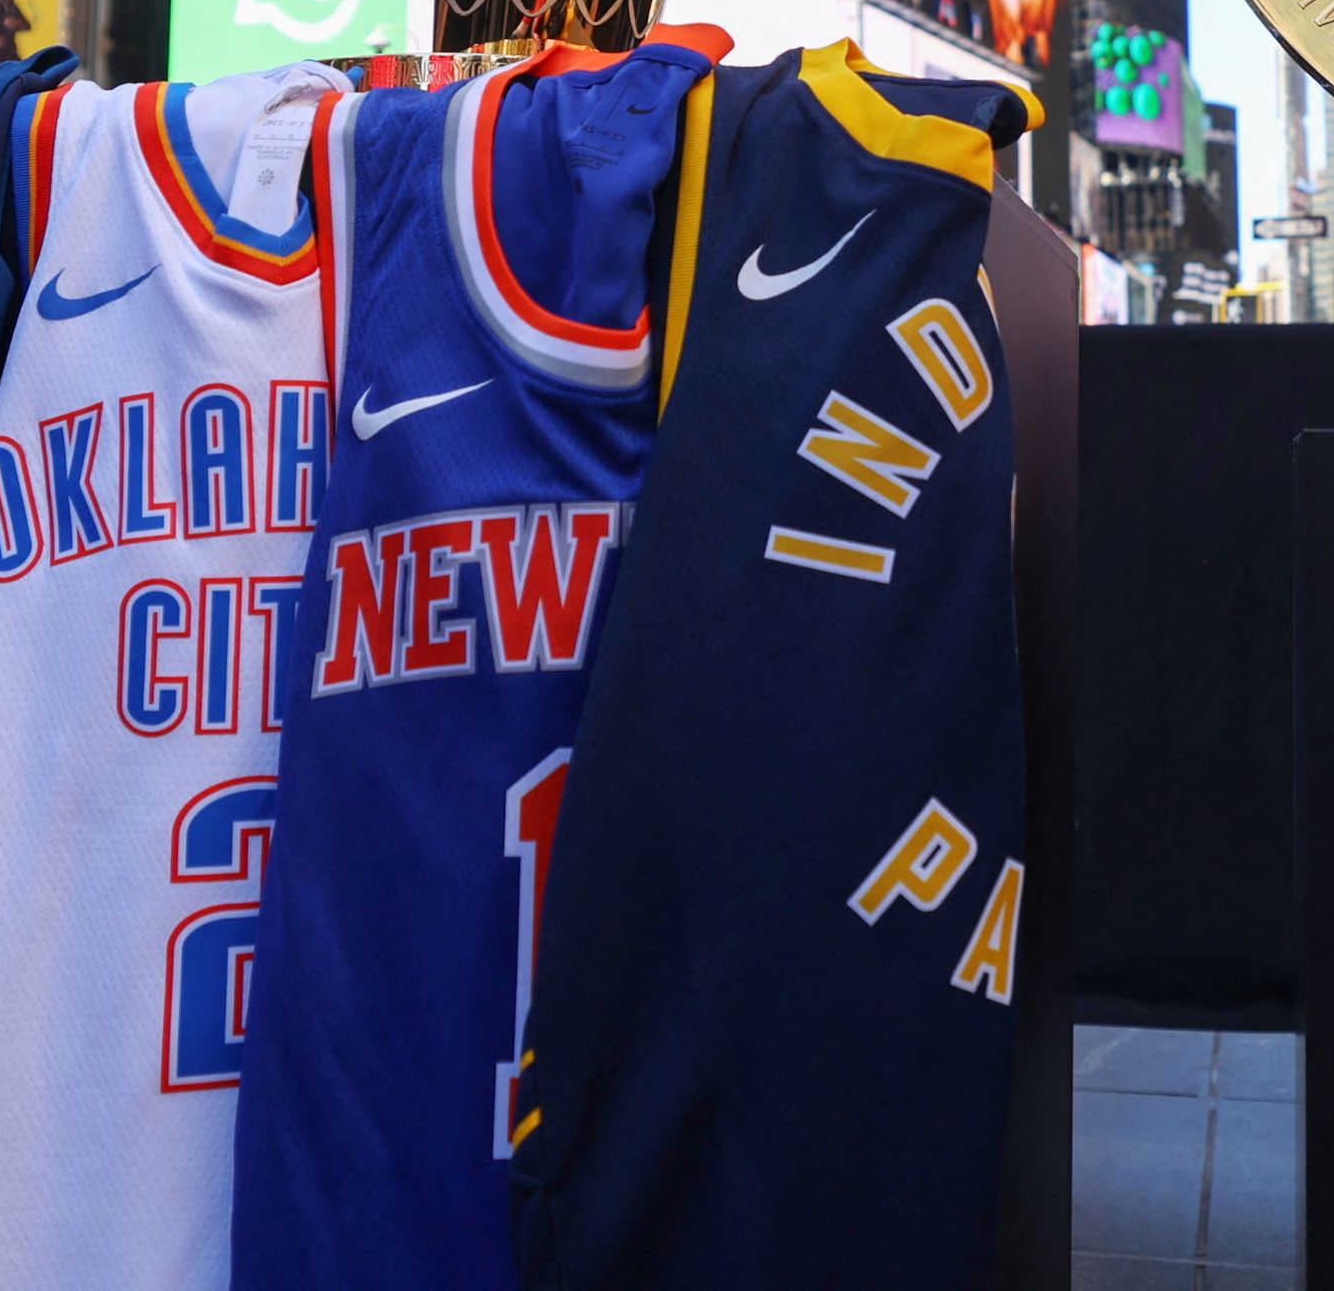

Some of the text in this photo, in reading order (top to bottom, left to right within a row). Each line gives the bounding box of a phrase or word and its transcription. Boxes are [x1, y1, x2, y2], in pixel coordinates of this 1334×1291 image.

[405, 55, 467, 86] LARRY
[764, 298, 993, 584] IND
[311, 502, 617, 700] NEW
[847, 797, 1025, 1005] PA
